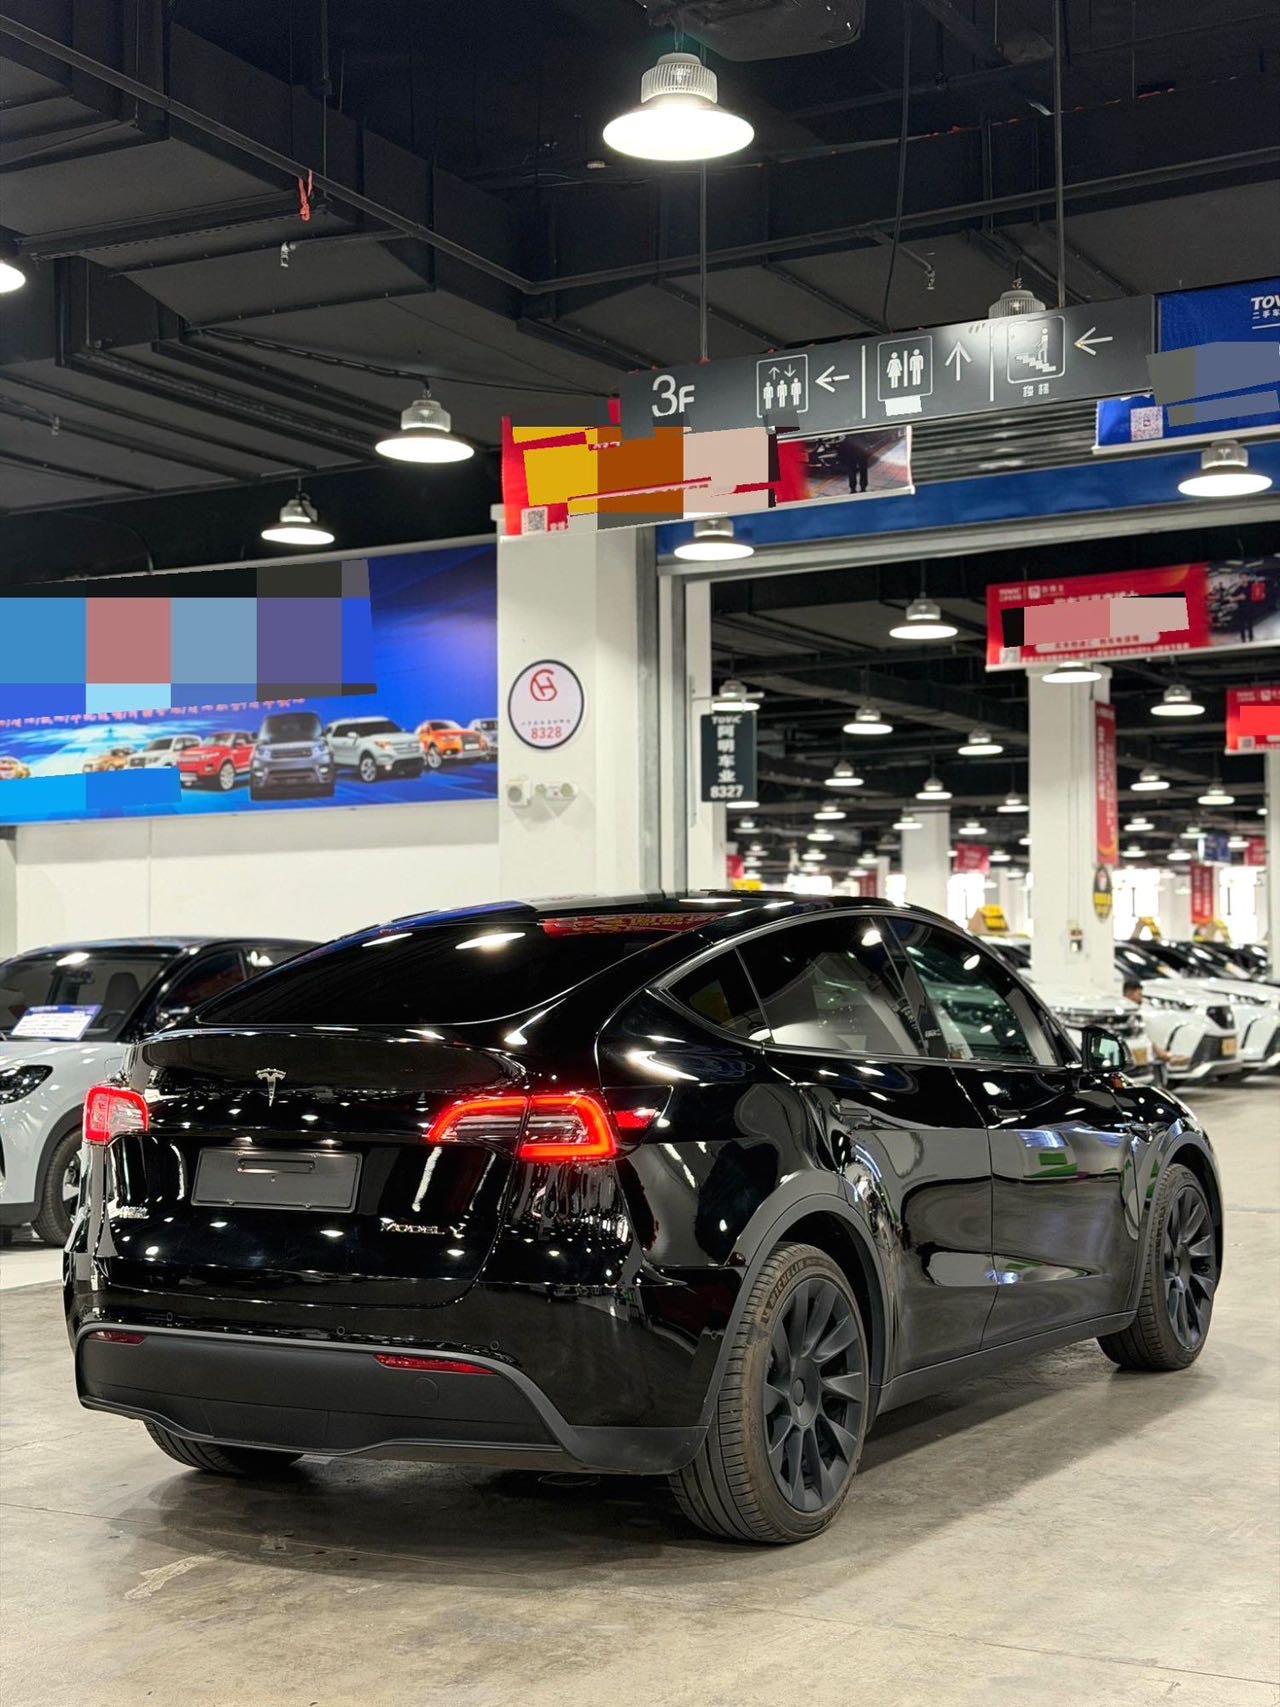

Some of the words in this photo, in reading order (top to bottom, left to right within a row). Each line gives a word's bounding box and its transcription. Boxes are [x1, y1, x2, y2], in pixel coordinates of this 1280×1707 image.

[651, 374, 695, 417] 3F
[531, 726, 562, 739] 8328
[709, 785, 745, 798] 8327
